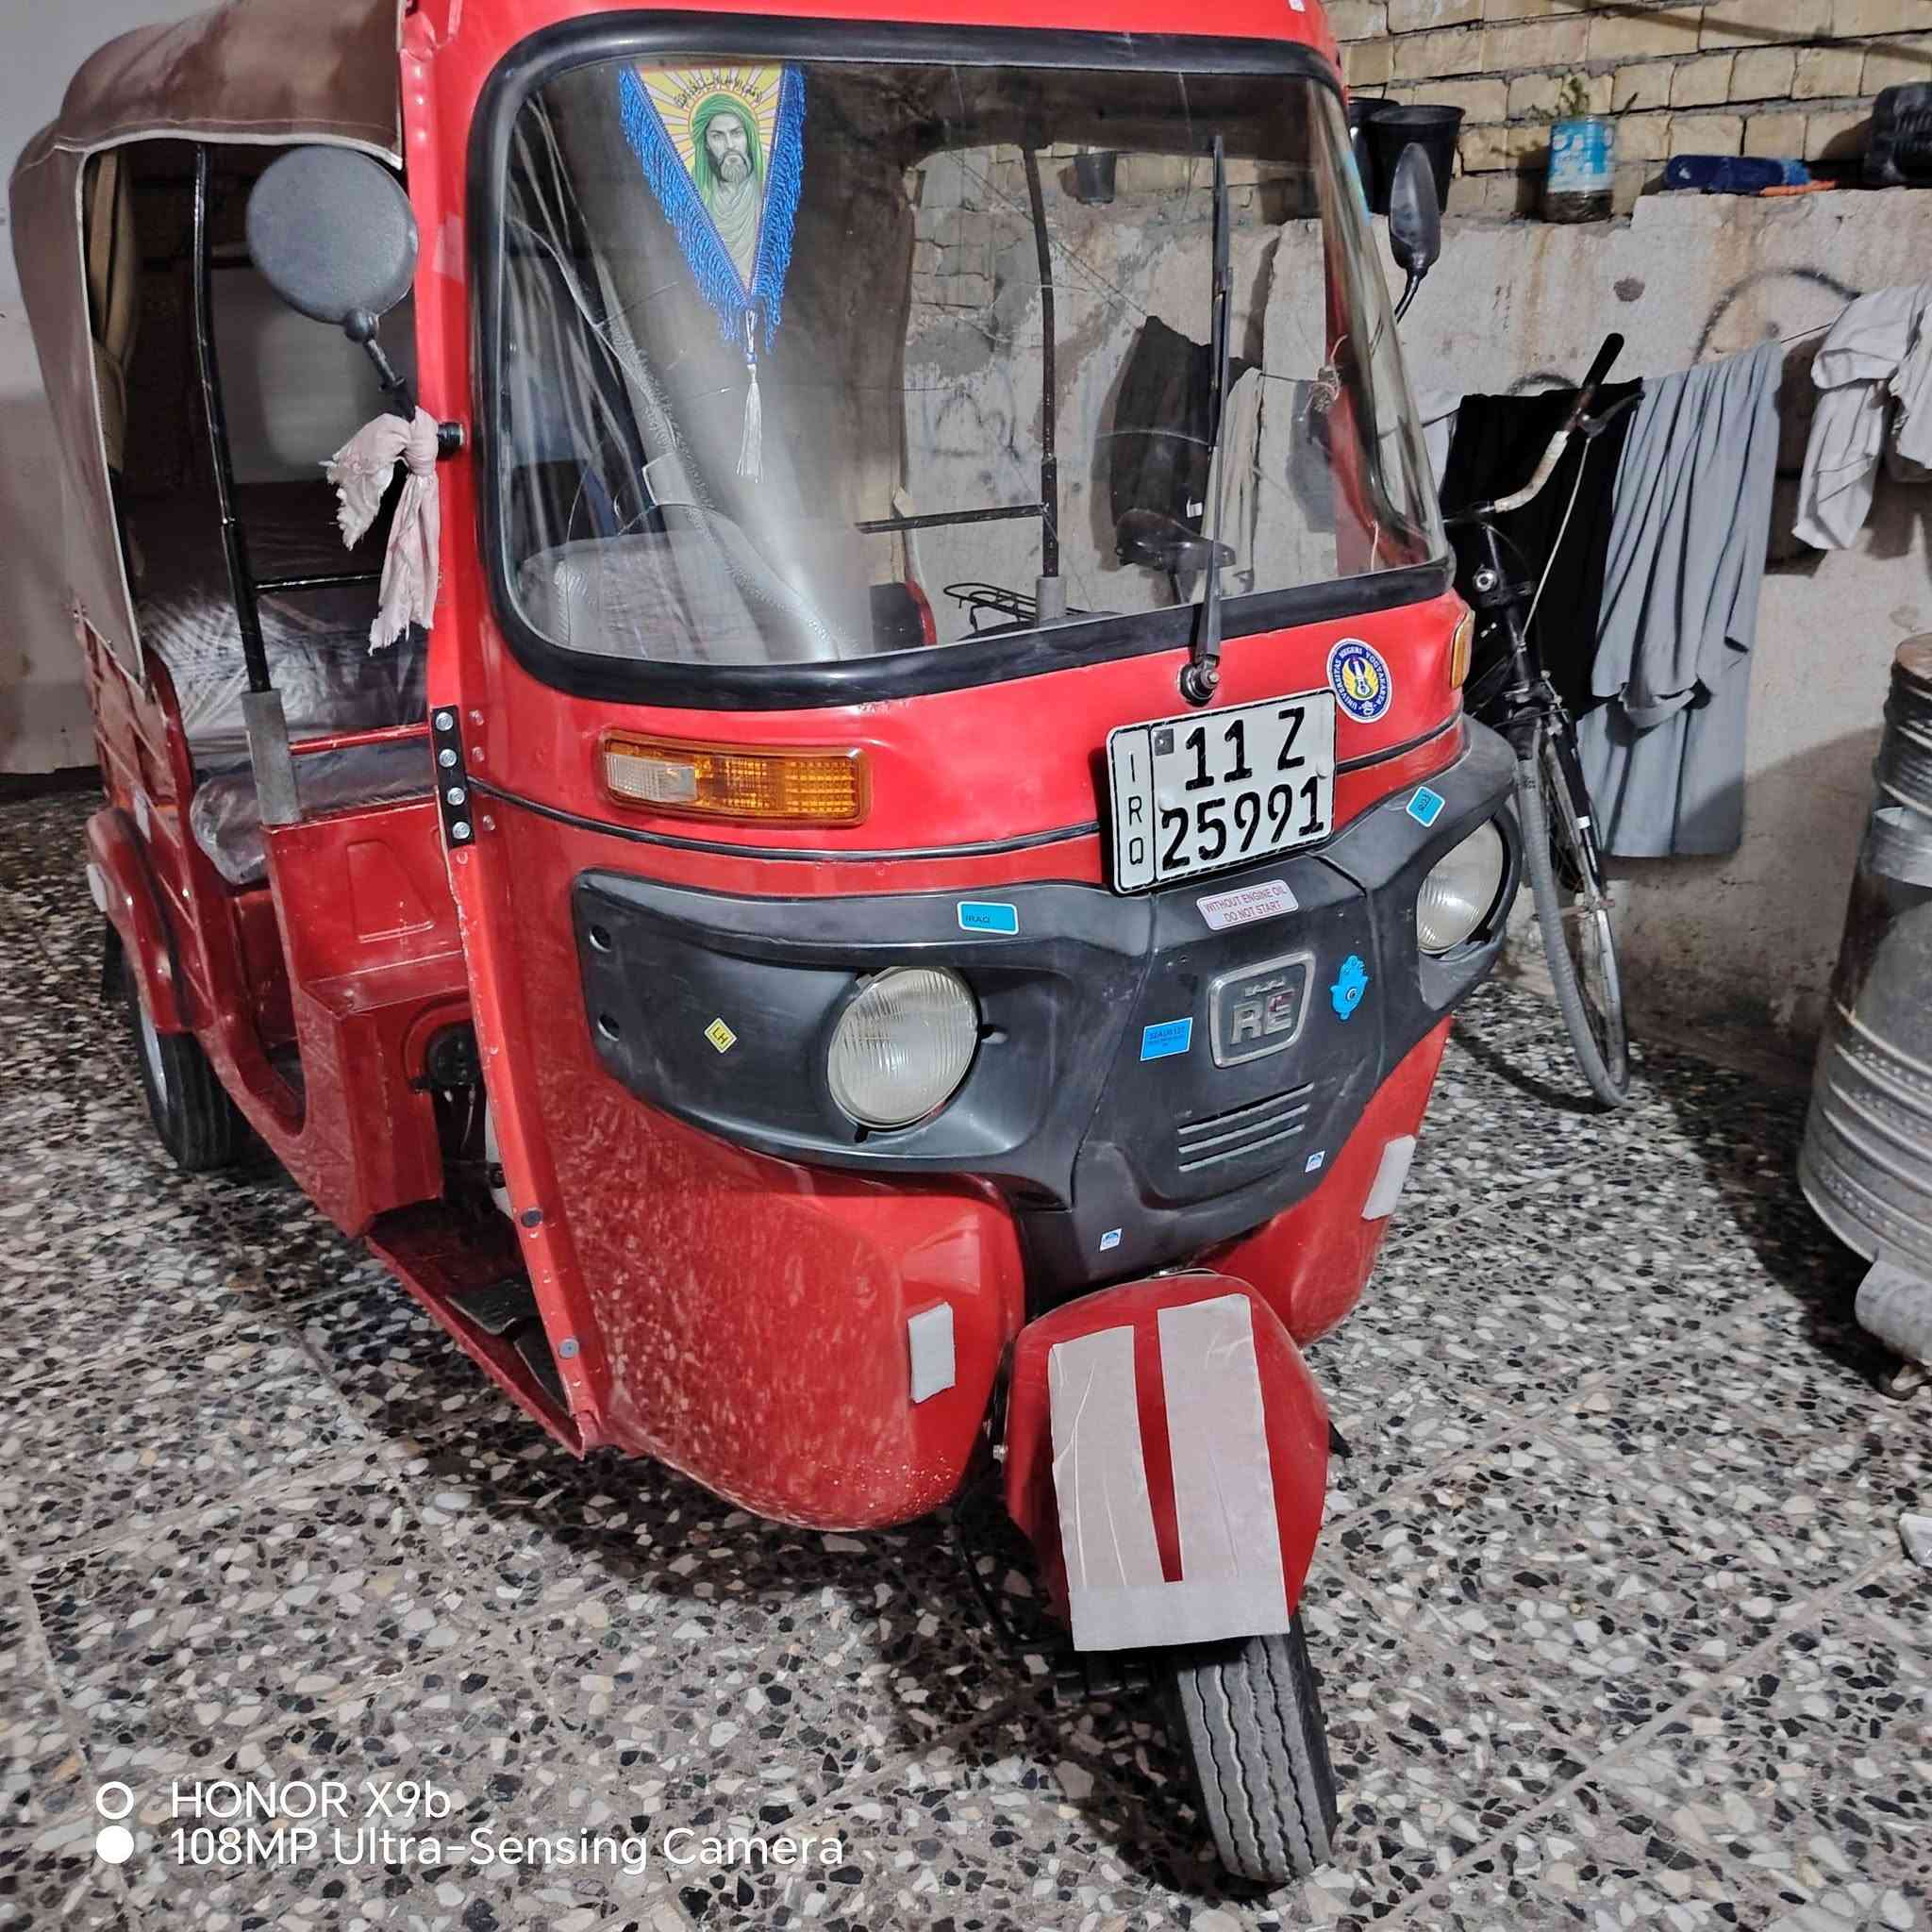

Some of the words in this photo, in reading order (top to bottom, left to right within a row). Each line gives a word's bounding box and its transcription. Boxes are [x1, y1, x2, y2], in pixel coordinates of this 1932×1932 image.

[1185, 719, 1254, 791] 11
[1277, 707, 1306, 772] Z
[1161, 775, 1324, 872] 25991
[1238, 906, 1257, 919] NOT
[712, 1026, 728, 1044] LH
[1230, 989, 1294, 1045] RE
